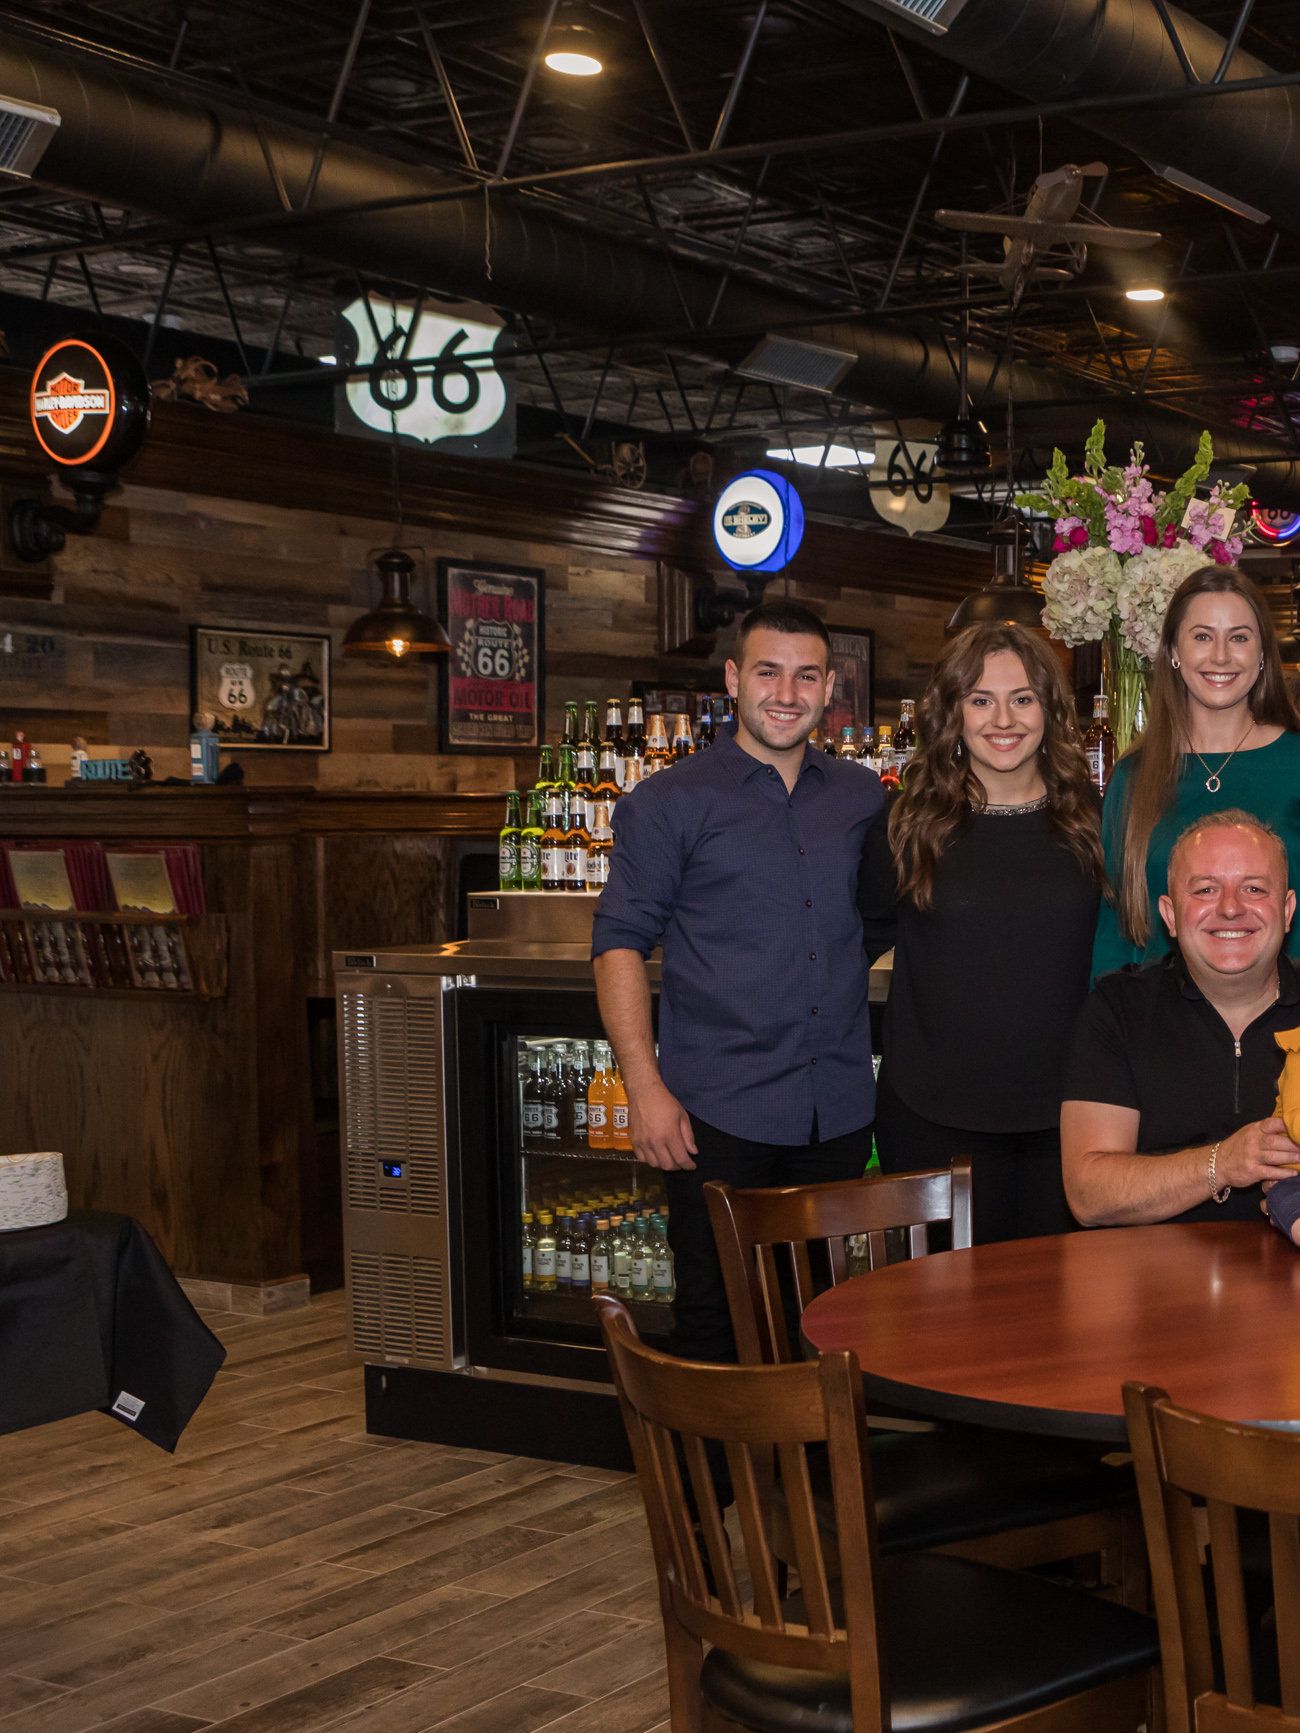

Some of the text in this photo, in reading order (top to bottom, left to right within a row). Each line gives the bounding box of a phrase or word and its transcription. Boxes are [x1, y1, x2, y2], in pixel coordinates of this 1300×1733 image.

[238, 641, 275, 658] Route
[278, 648, 293, 659] 66
[477, 639, 510, 648] ROUTE
[477, 646, 511, 677] 66
[227, 688, 248, 704] 66
[453, 687, 532, 709] MOTOR OIL
[469, 712, 514, 723] THE GREAT
[524, 1113, 539, 1123] 66
